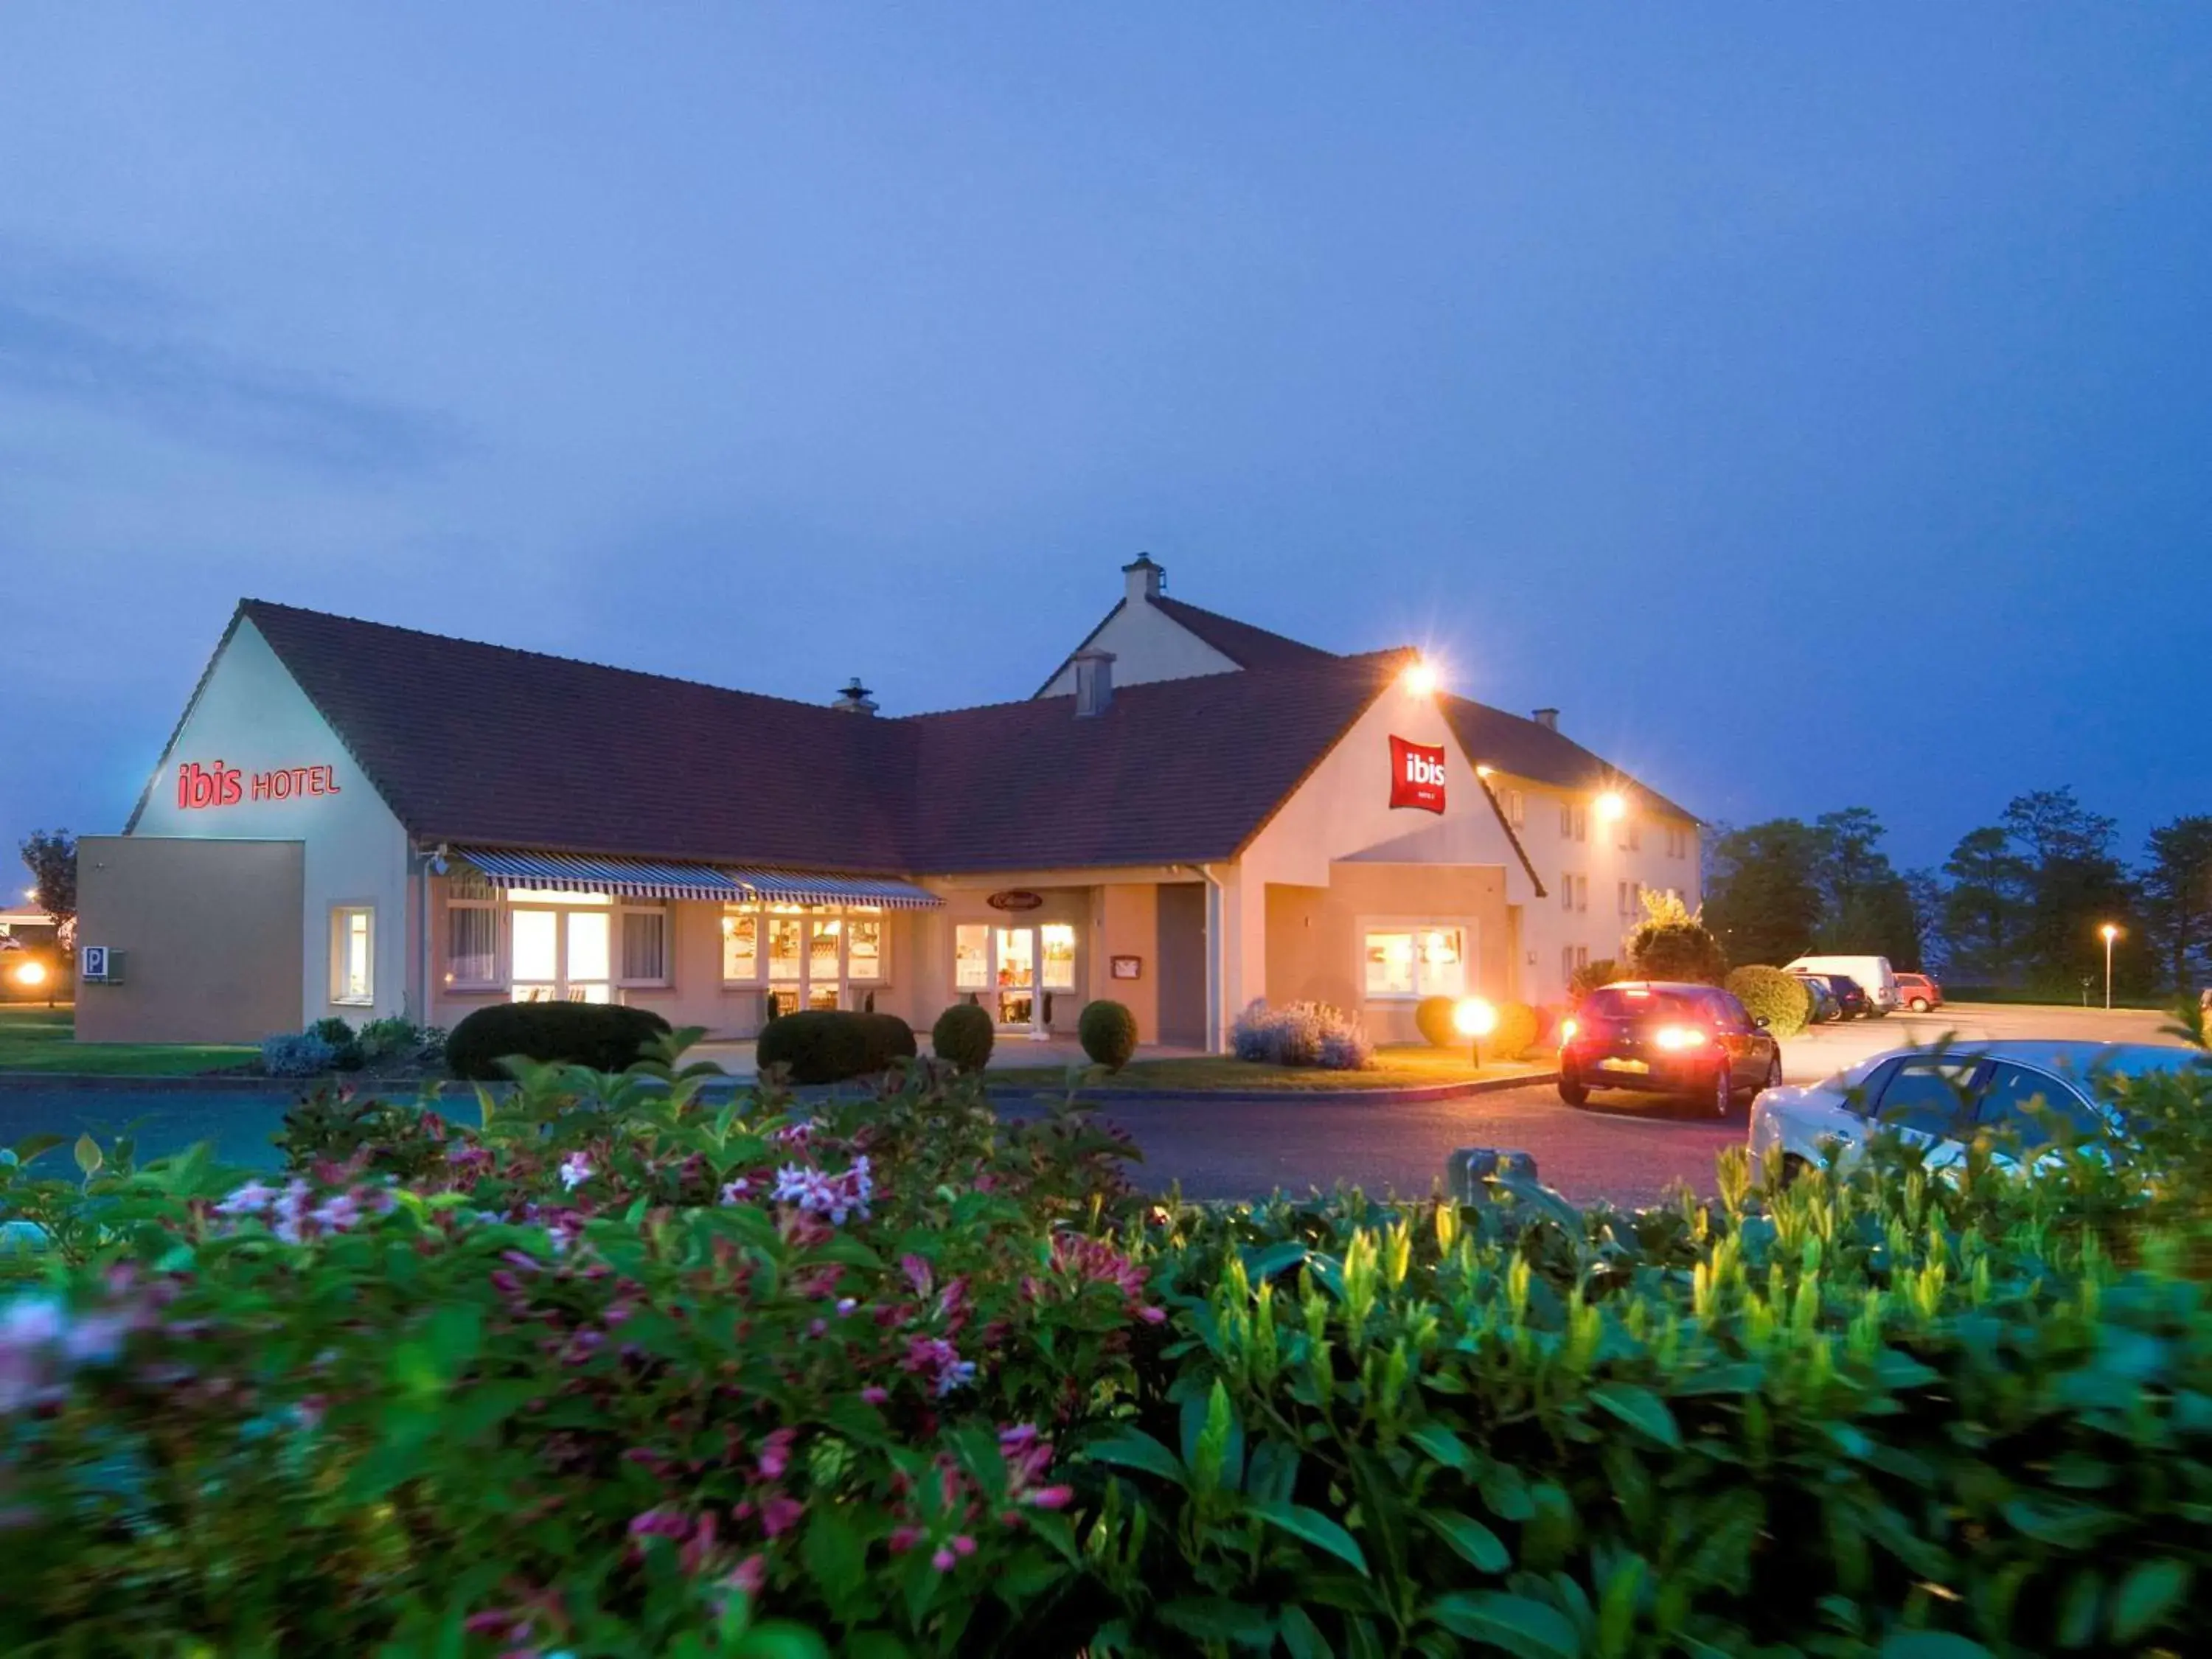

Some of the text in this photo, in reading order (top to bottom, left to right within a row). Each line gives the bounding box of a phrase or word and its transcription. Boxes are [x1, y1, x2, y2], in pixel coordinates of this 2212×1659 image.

[178, 759, 341, 809] ibis HOTEL
[1406, 752, 1444, 786] ibis
[89, 949, 101, 973] P
